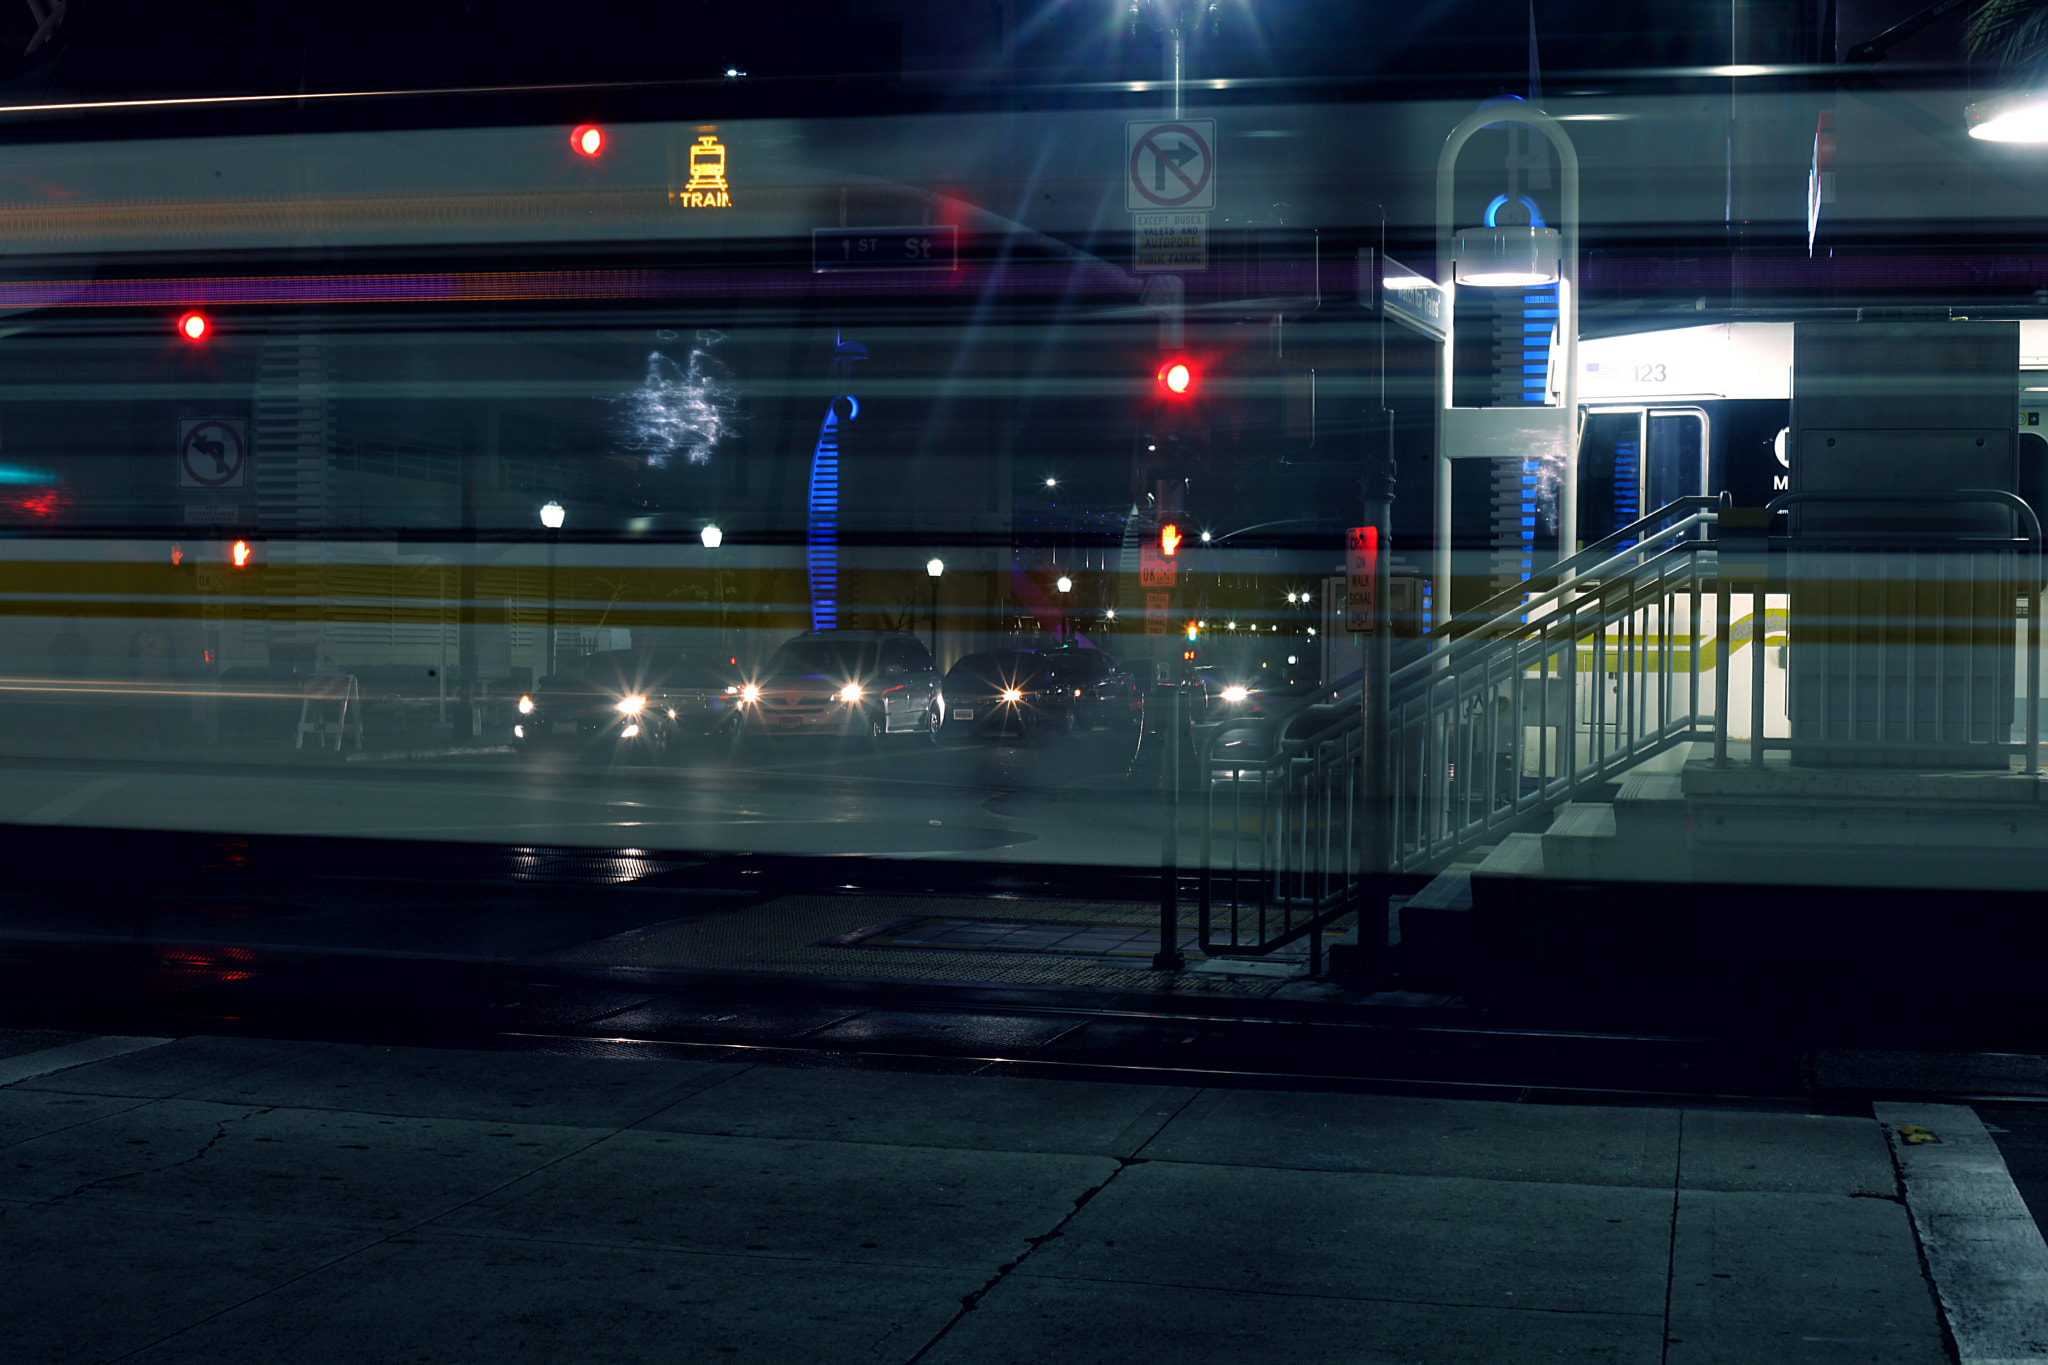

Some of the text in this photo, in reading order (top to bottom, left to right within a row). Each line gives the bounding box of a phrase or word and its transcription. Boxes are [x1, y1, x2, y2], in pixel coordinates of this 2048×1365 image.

[679, 191, 733, 208] TRAIN
[1138, 215, 1168, 226] EXCEPT
[1181, 226, 1198, 236] AND
[904, 236, 933, 260] St
[1144, 237, 1196, 249] AUTOPORT
[1139, 252, 1202, 265] PUBLIC PARKING
[1632, 363, 1667, 382] 123
[1356, 556, 1366, 569] ON
[198, 575, 212, 587] OK
[1143, 567, 1156, 582] OK
[1351, 575, 1369, 587] WALK
[1349, 593, 1372, 606] SIGNAL
[1352, 610, 1369, 624] ONLY
